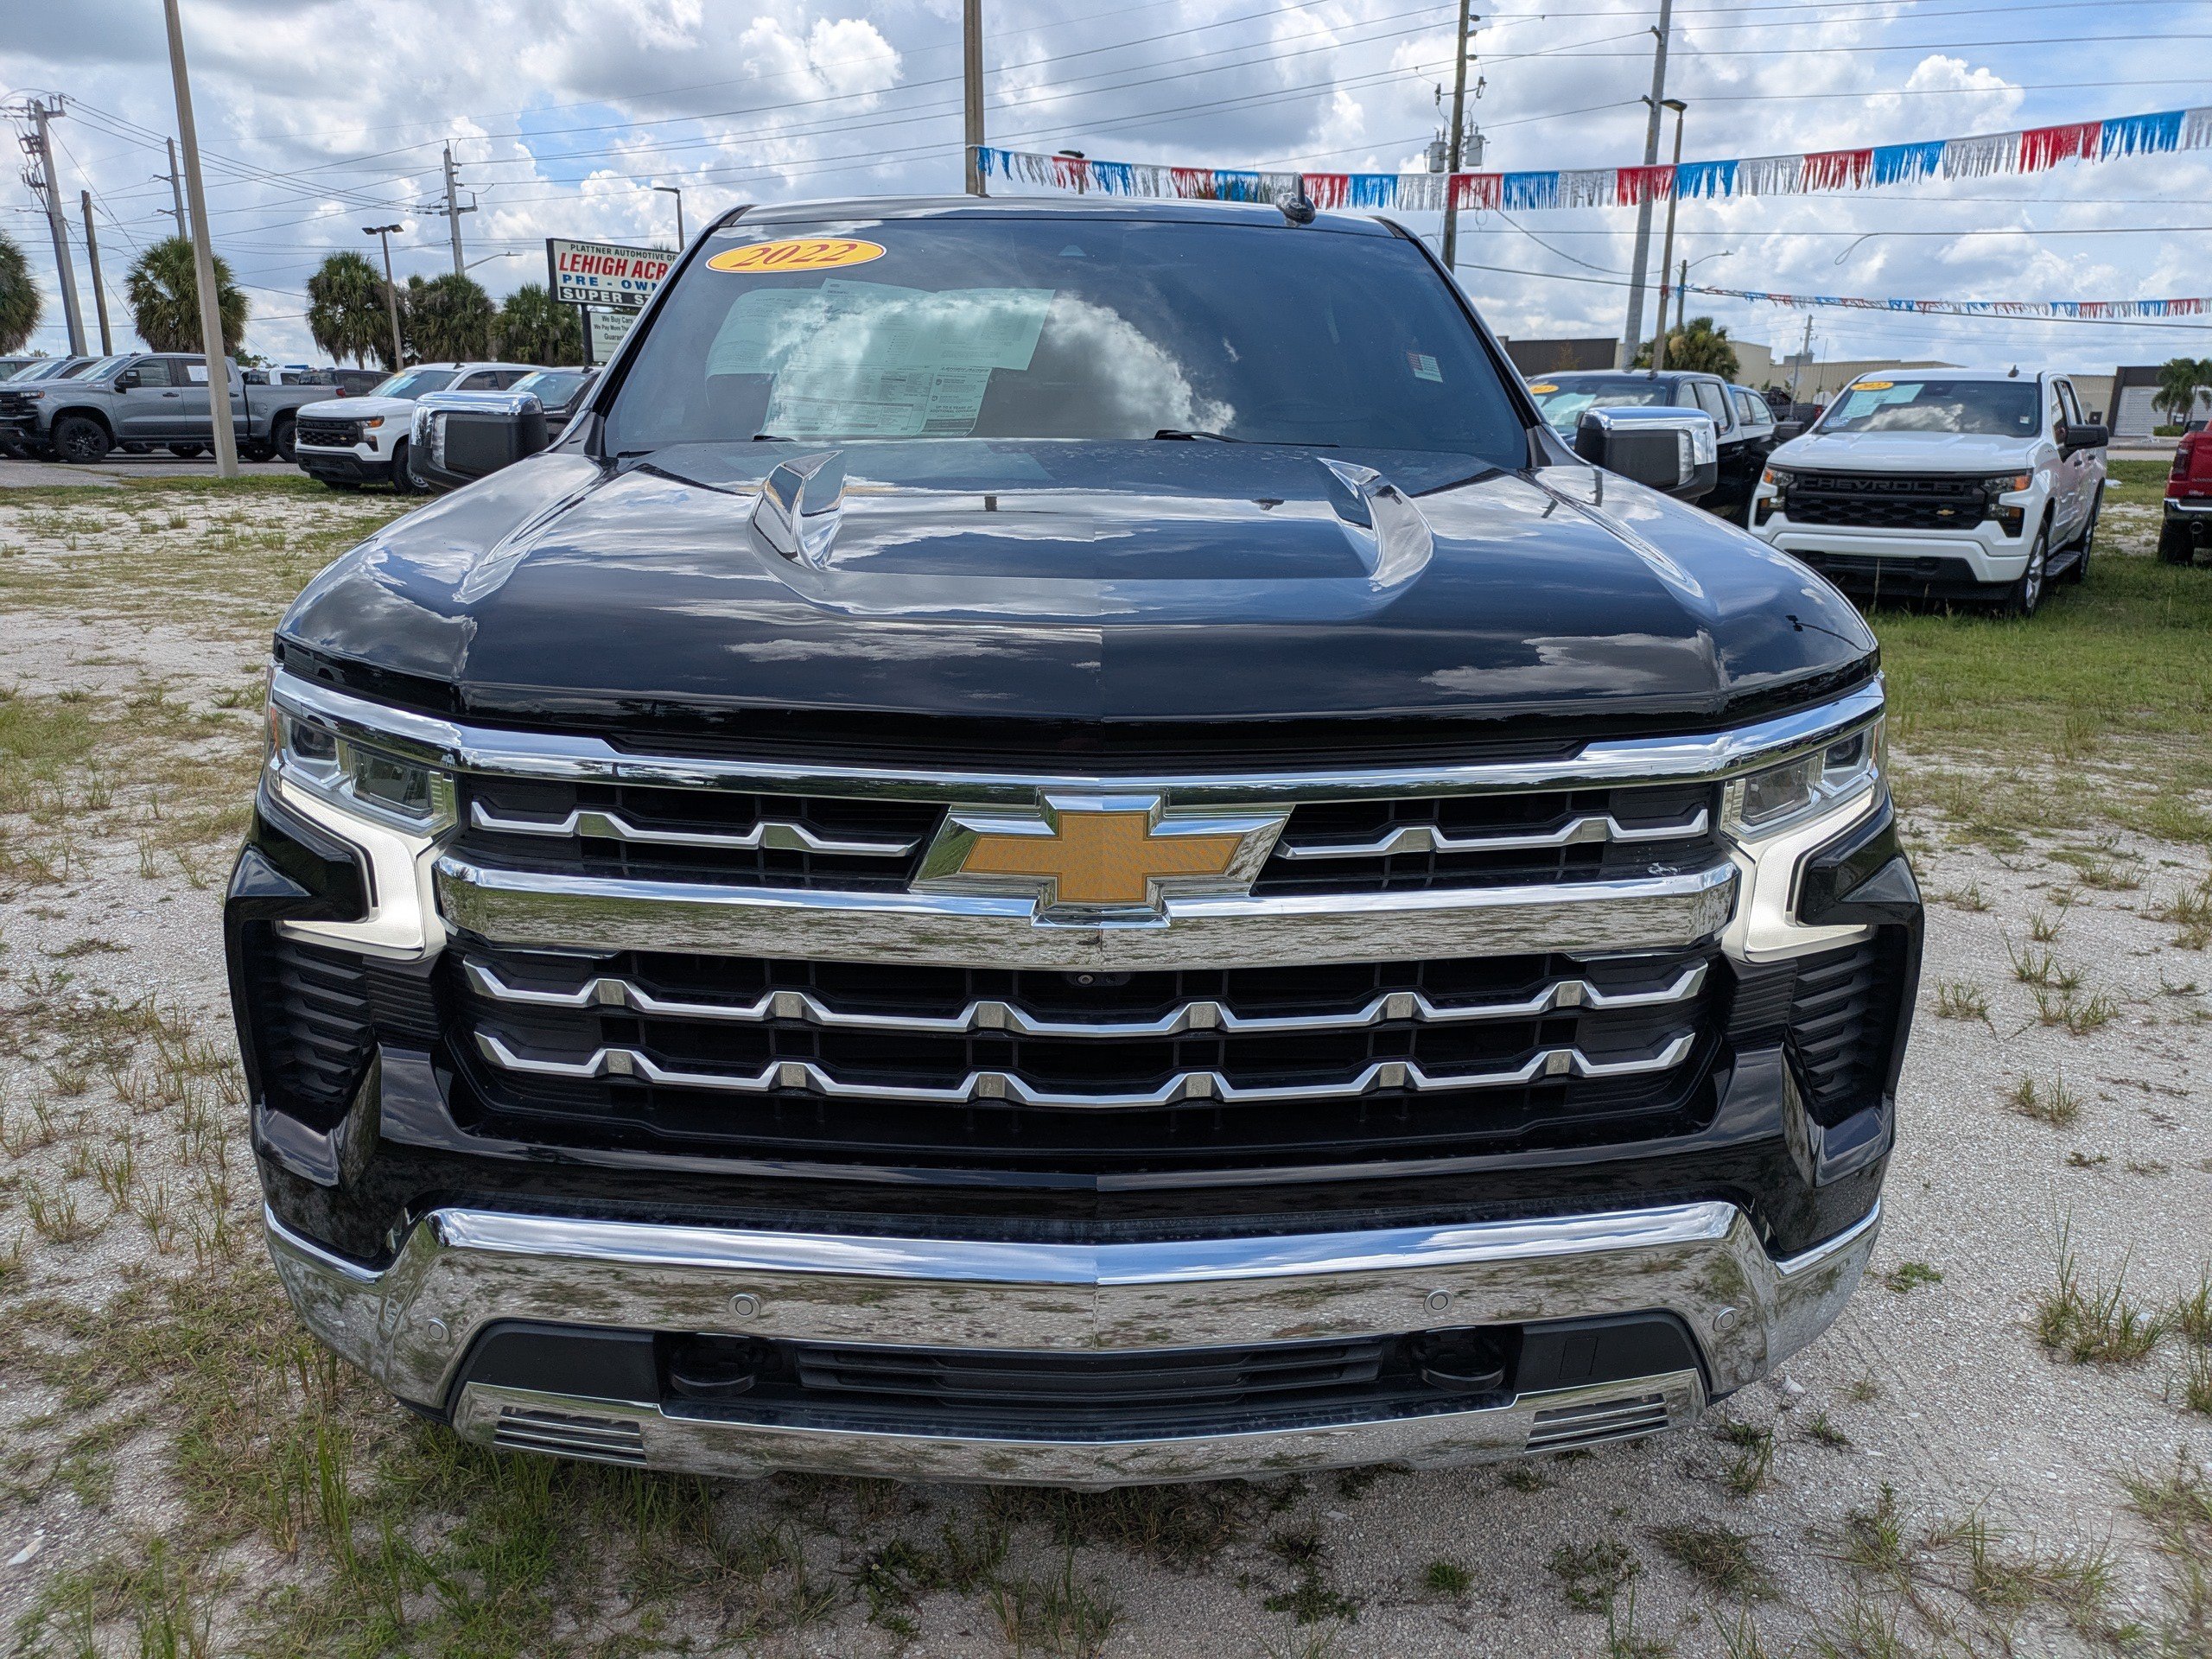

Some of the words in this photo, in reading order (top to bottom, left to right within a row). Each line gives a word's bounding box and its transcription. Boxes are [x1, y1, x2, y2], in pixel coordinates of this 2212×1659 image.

[570, 244, 612, 256] PLATTNER
[614, 248, 664, 261] AUTOMOTIVE
[730, 244, 858, 268] 2022
[559, 252, 628, 277] LEHIGH
[631, 259, 670, 281] ACR
[563, 274, 599, 287] PRE
[563, 288, 623, 303] SUPER
[611, 315, 621, 324] Buy
[1801, 477, 1967, 493] CHEVROLET
